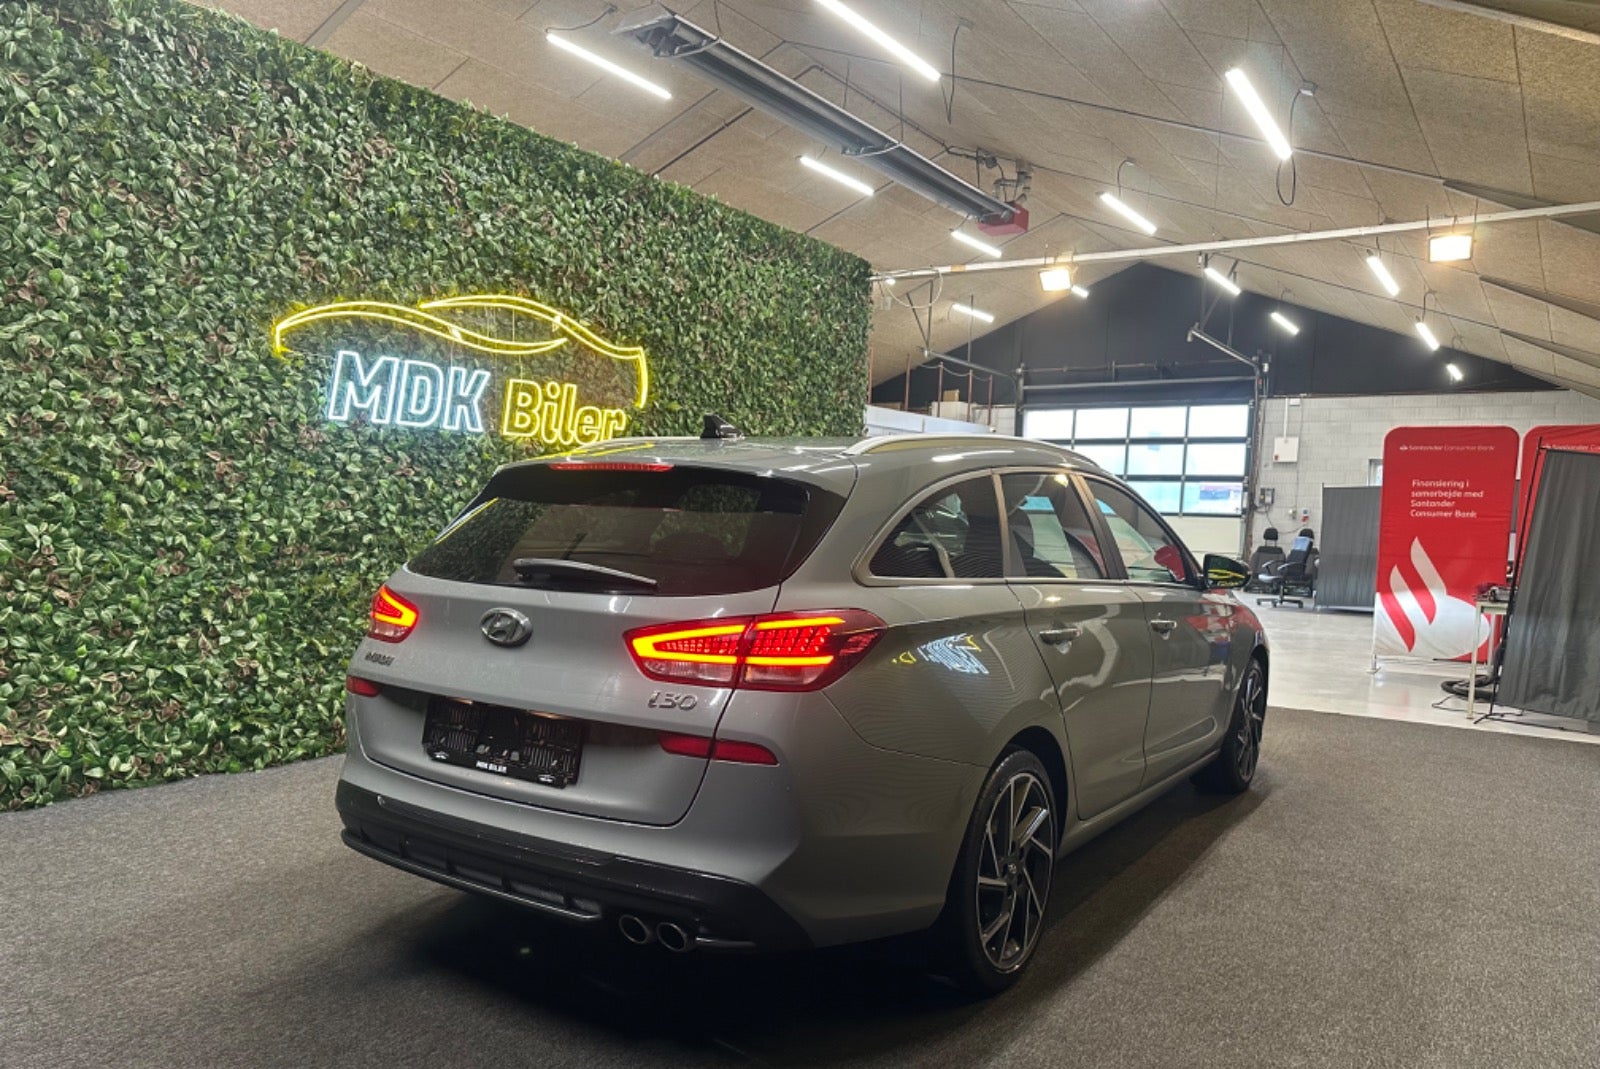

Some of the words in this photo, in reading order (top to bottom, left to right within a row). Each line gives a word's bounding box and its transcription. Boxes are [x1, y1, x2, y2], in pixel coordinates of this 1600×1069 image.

[328, 350, 490, 432] MDK
[502, 378, 626, 446] Biler
[1411, 479, 1465, 489] Finansiering
[1411, 489, 1462, 499] samarbejde
[1463, 490, 1484, 498] med
[1410, 499, 1456, 507] Santander
[1410, 509, 1453, 517] Consumer
[1454, 509, 1477, 518] Bank
[647, 691, 698, 711] i30
